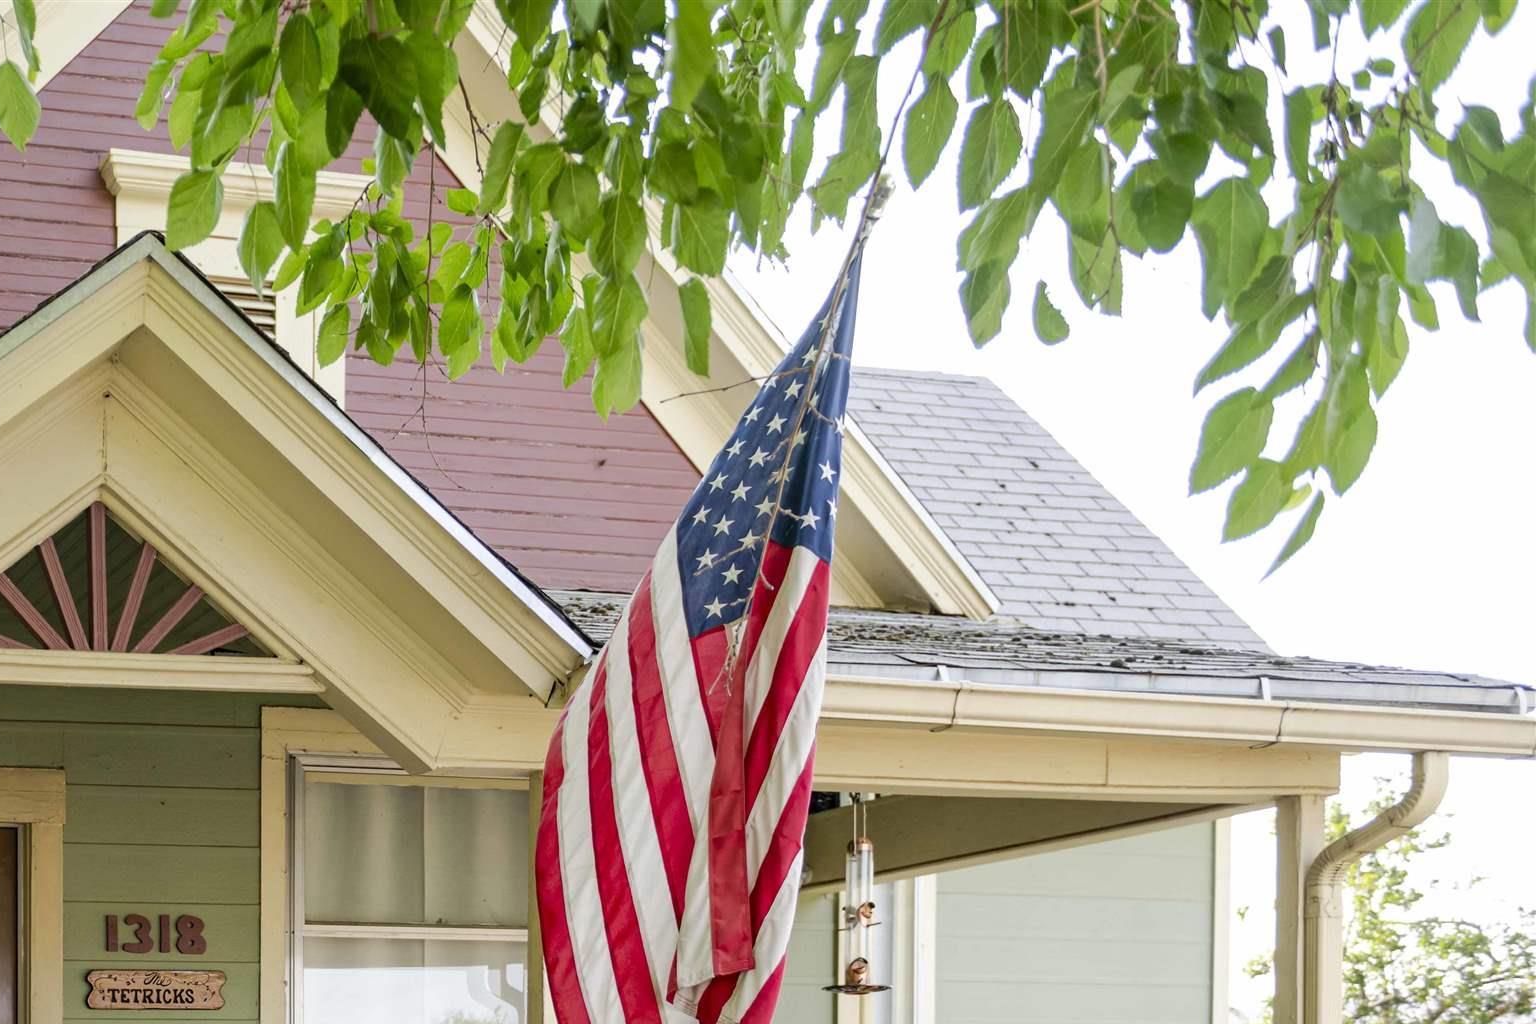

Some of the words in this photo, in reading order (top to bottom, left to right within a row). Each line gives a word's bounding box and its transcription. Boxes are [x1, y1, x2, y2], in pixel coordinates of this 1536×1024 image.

[105, 913, 207, 955] 1318
[143, 971, 173, 987] The
[107, 988, 195, 1004] TETRICKS
